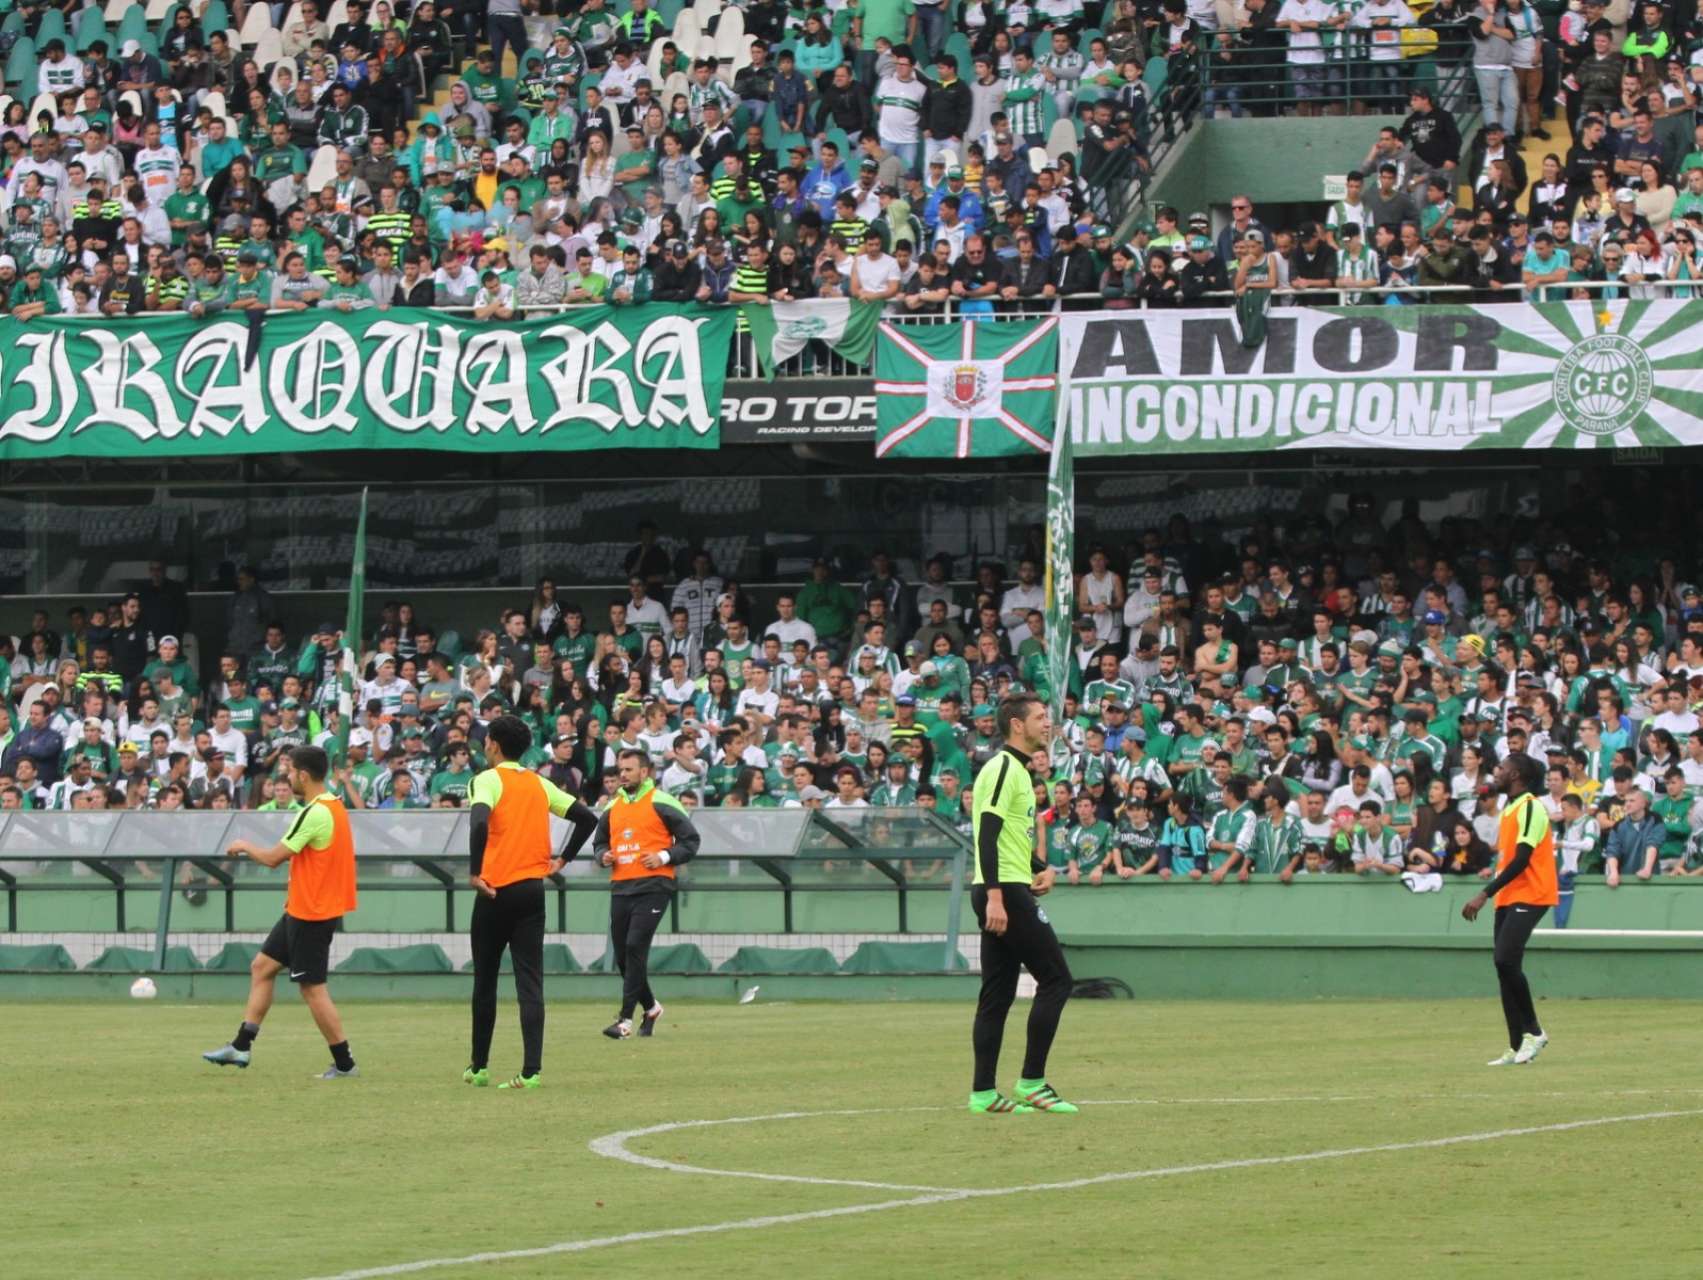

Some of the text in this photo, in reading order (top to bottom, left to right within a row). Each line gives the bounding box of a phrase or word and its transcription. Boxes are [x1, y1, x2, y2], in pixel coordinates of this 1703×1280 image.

[0, 317, 716, 442] IRAQUARA
[1070, 315, 1501, 378] AMOR
[1071, 379, 1503, 445] INCONDICIONAL
